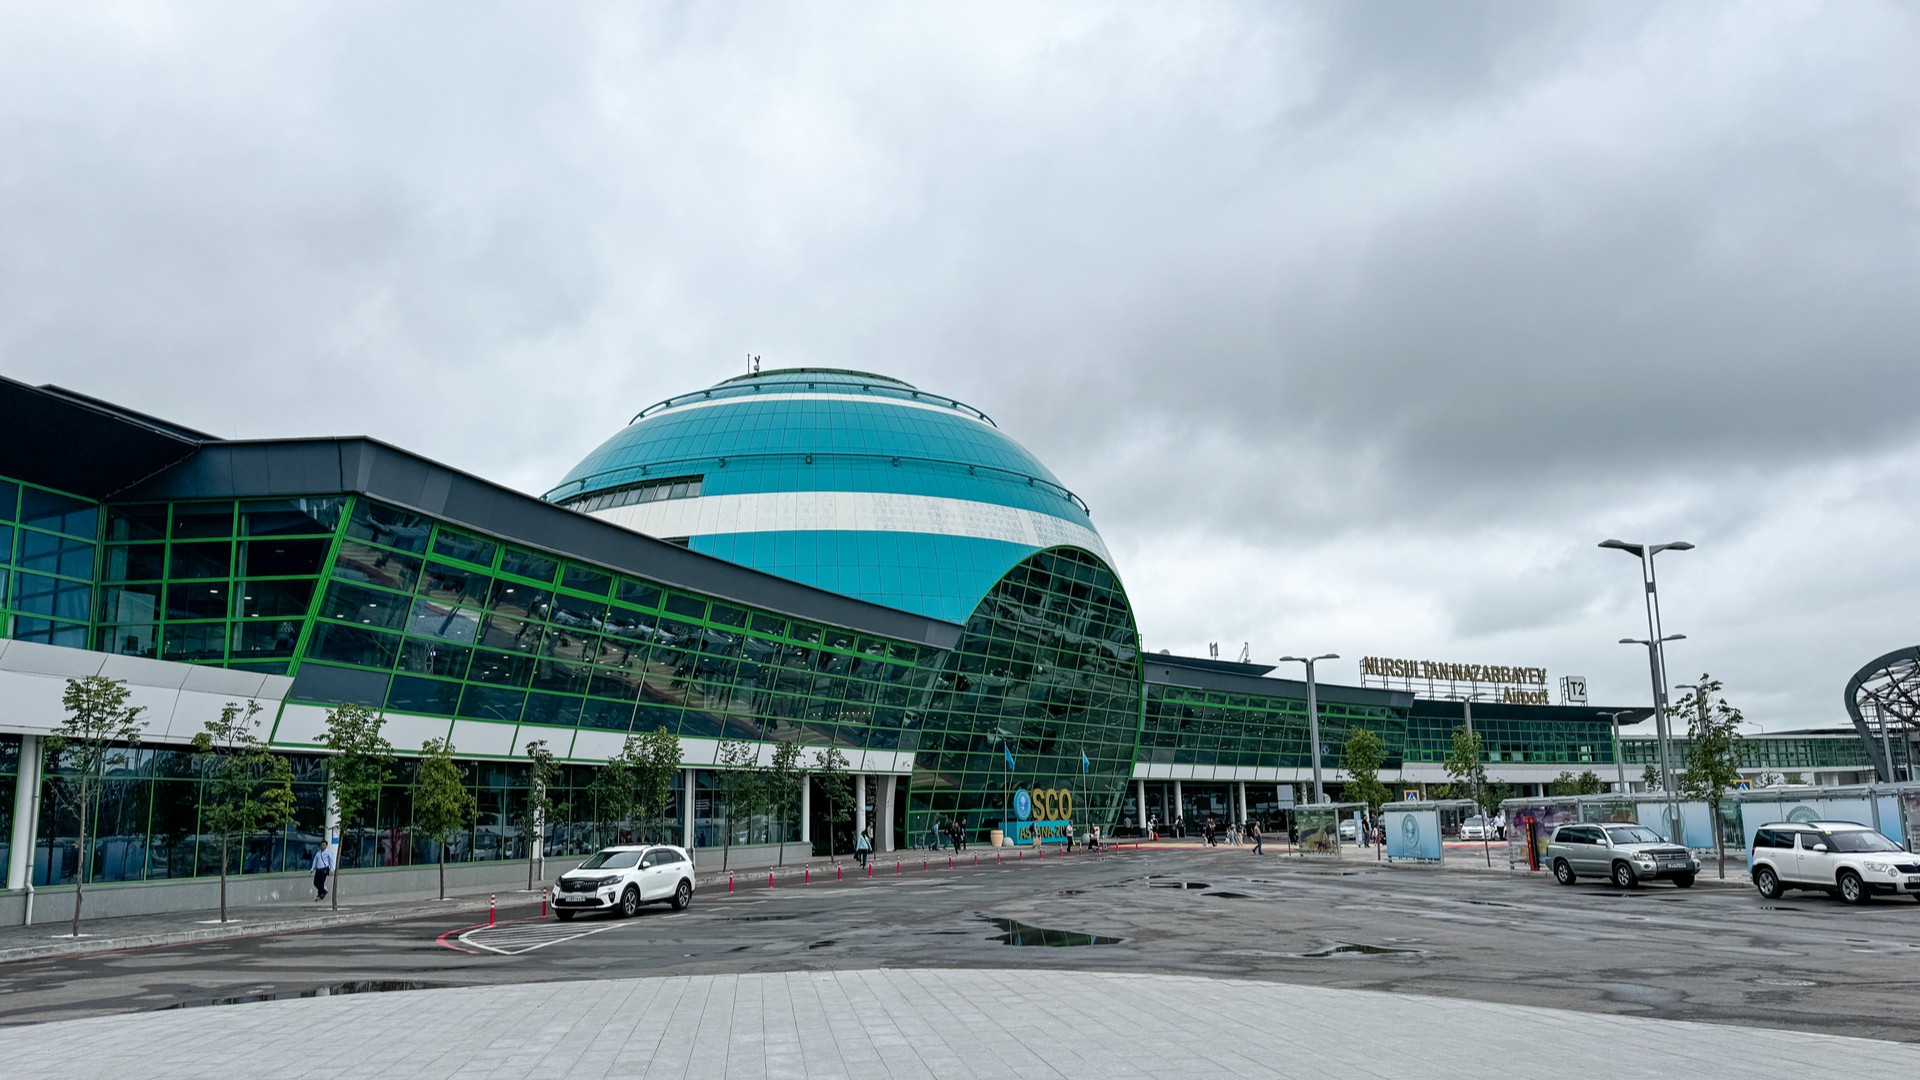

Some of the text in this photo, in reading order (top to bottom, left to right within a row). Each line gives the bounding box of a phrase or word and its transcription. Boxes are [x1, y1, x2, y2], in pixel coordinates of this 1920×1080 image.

[1364, 656, 1547, 685] NURSULTAN NAZARBAYEV
[1503, 686, 1549, 705] Airport
[1570, 681, 1585, 696] T2
[1032, 788, 1073, 821] SCO
